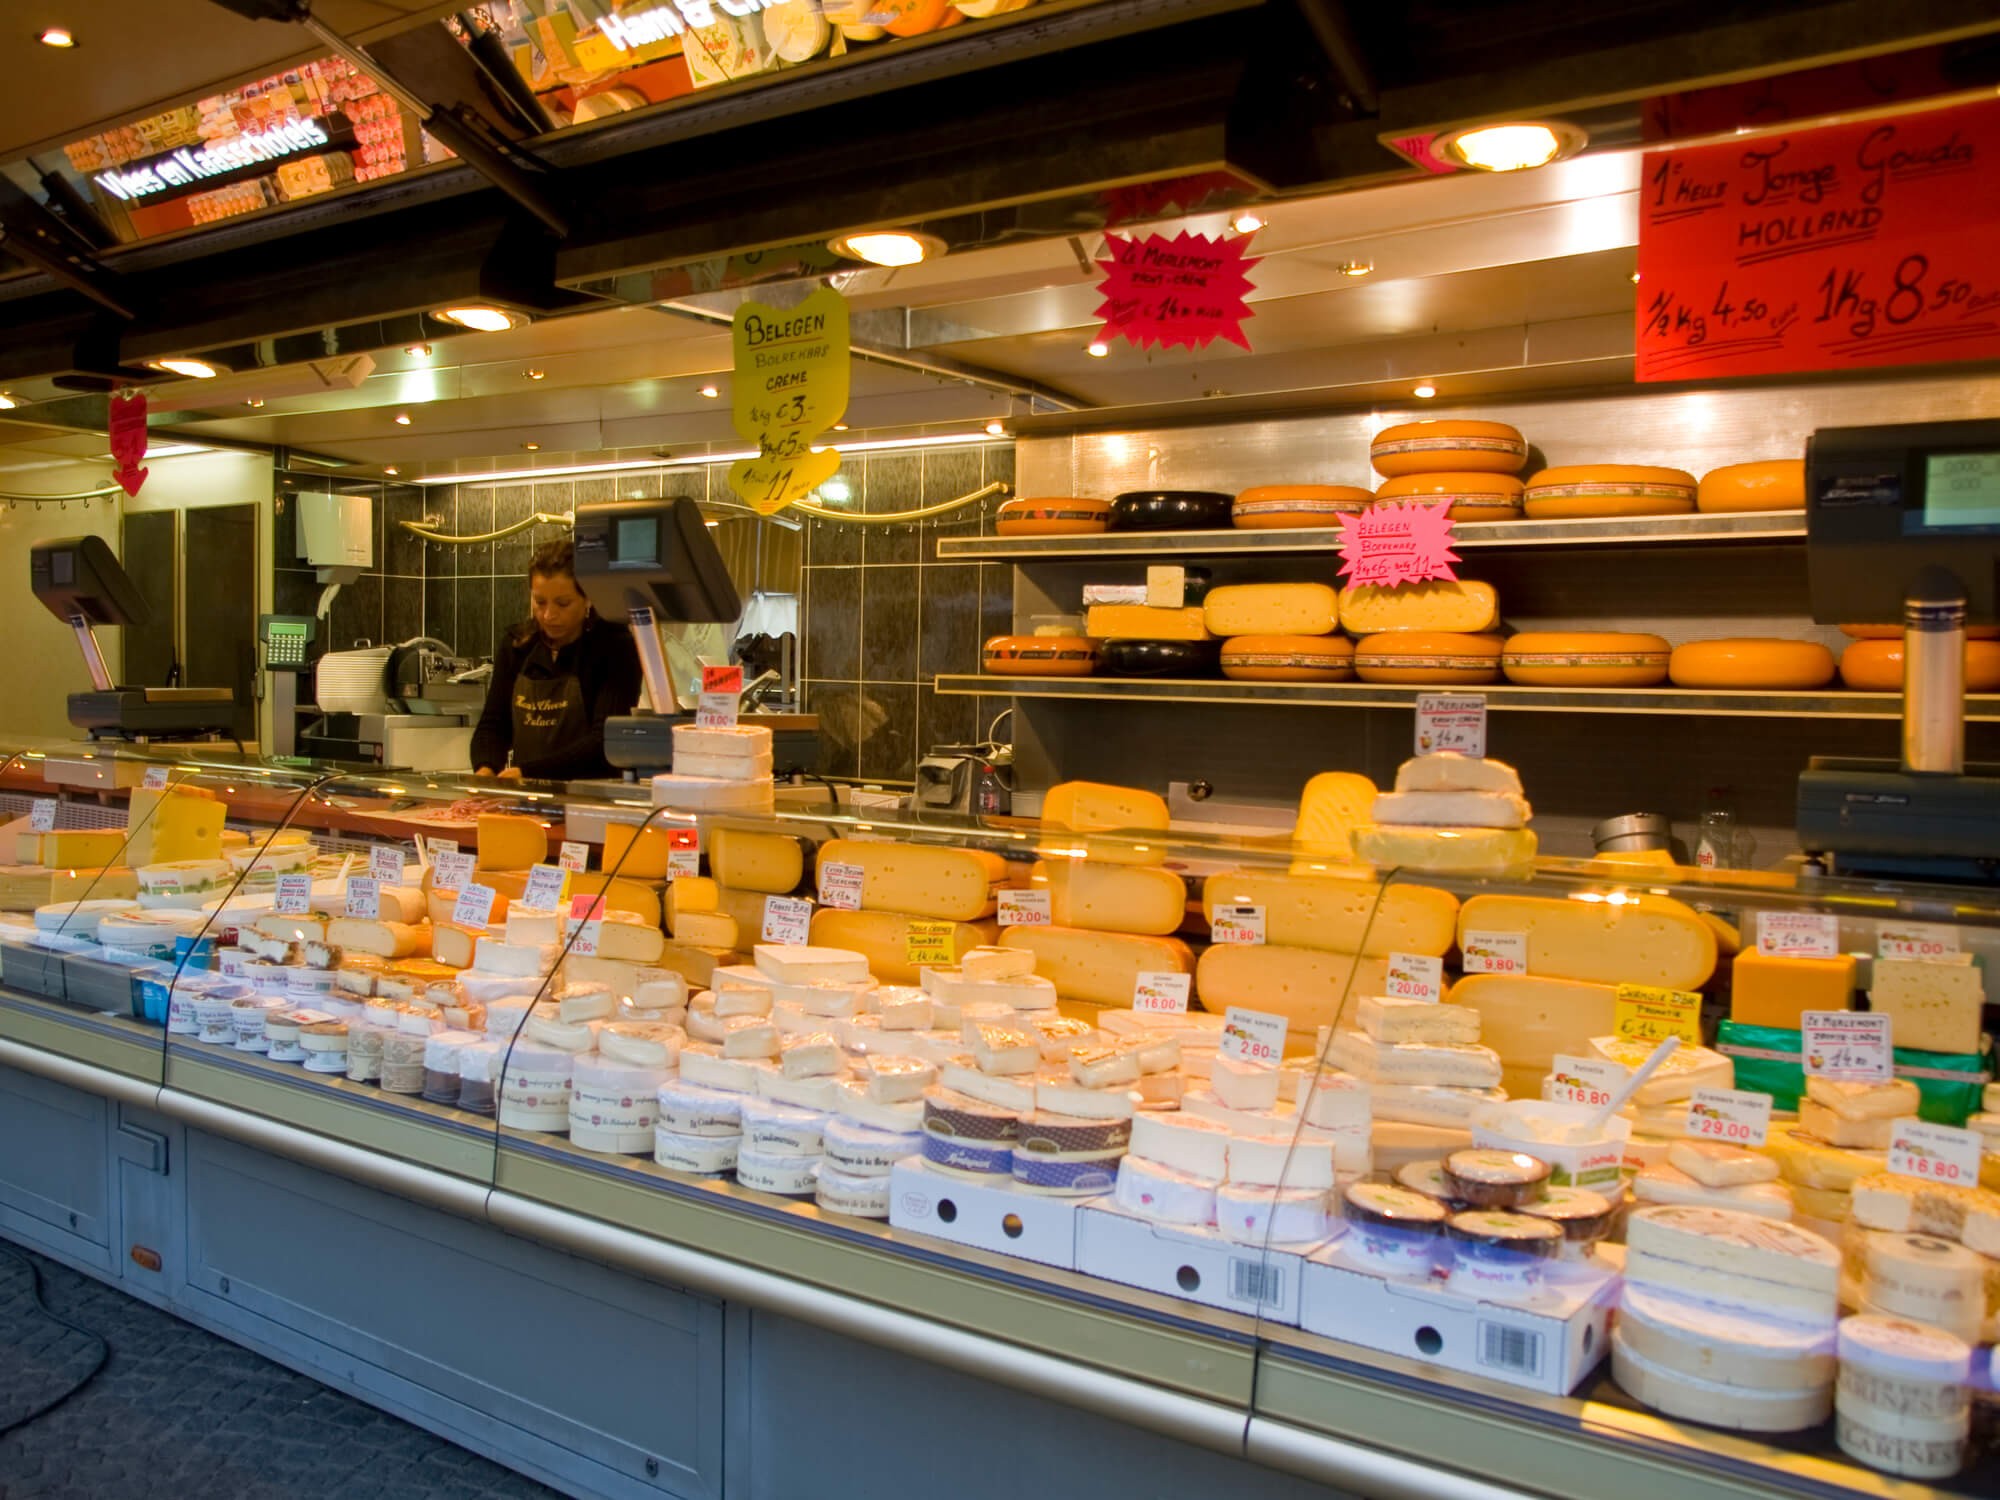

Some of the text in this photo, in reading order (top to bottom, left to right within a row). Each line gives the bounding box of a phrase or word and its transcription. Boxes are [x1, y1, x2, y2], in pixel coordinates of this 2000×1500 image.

[596, 7, 686, 51] Ham
[94, 116, 329, 201] Vlees en Kaasschotels
[1857, 124, 1976, 206] Gouda
[1737, 206, 1885, 247] HOLLAND
[743, 312, 826, 346] BELEGEN
[1357, 522, 1411, 536] BELEGEN
[1009, 911, 1041, 922] 12.00
[1222, 929, 1255, 941] 11.80
[1895, 942, 1944, 955] 14.00
[1484, 957, 1514, 972] 9.80
[1396, 981, 1429, 997] 20.00
[1144, 997, 1177, 1010] 16.00
[1239, 1040, 1271, 1059] 2.80
[1567, 1087, 1611, 1106] 16.80
[1701, 1118, 1751, 1139] 29.00
[1905, 1156, 1960, 1179] 16.80
